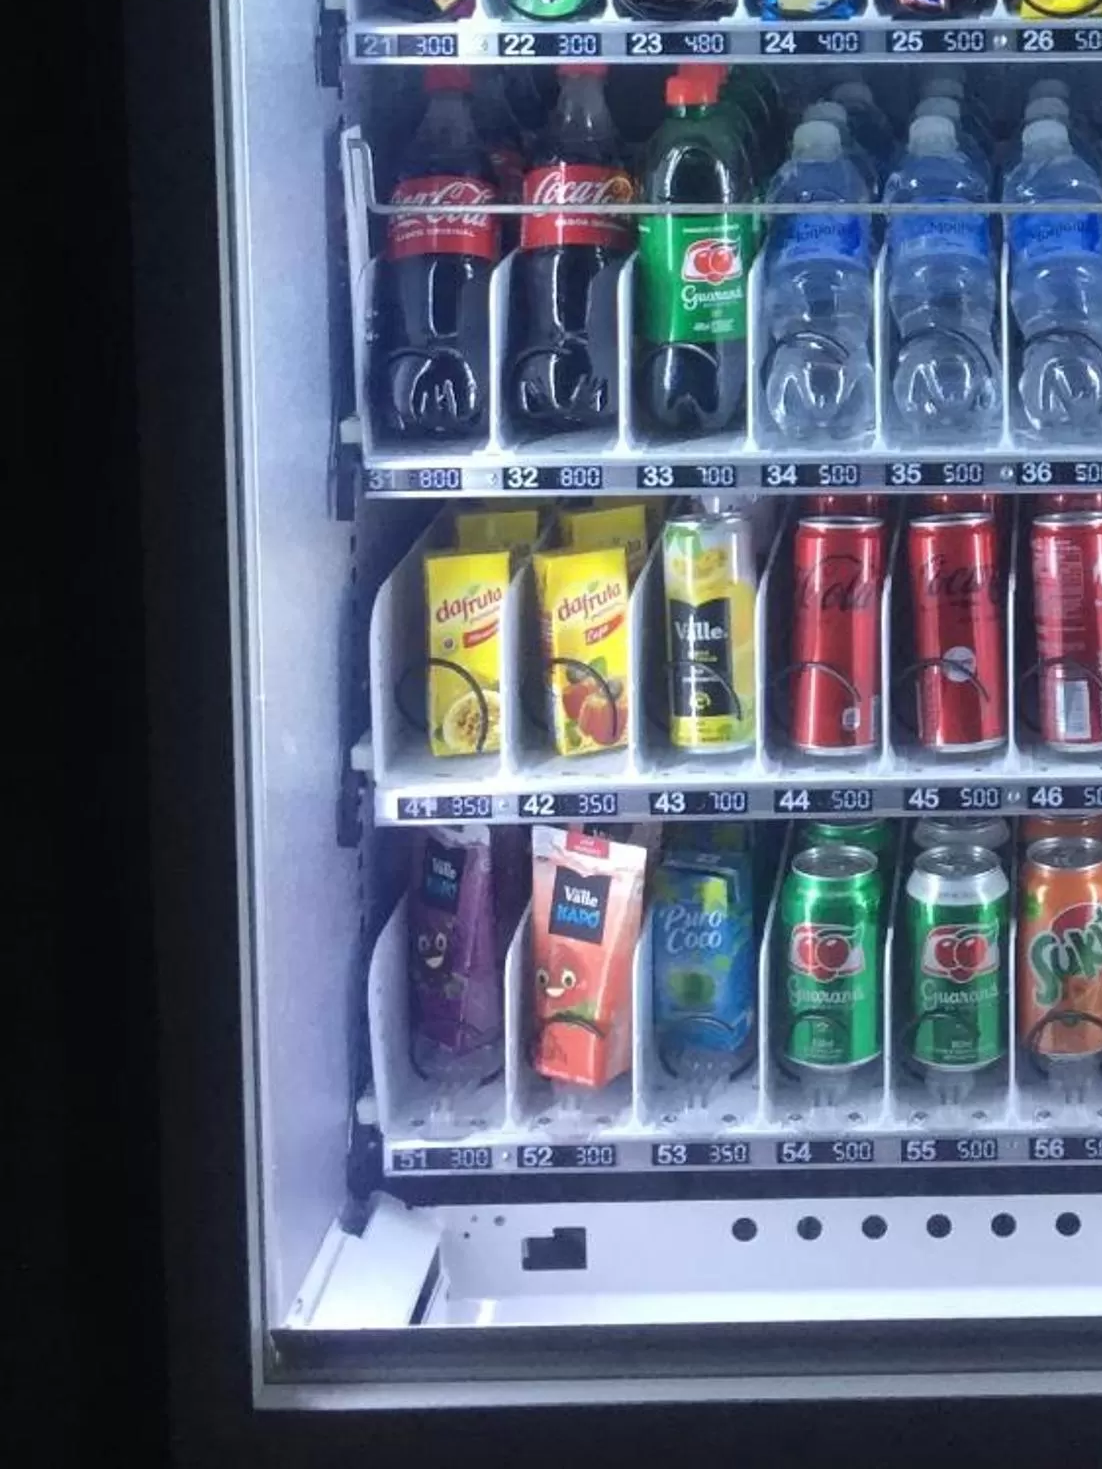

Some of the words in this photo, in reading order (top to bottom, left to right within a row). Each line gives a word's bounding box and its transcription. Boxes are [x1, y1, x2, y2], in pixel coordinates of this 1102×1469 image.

[363, 35, 391, 55] 21
[504, 35, 536, 55] 22
[632, 33, 662, 54] 23
[765, 32, 797, 53] 24
[893, 31, 923, 51] 25
[1023, 30, 1054, 51] 26
[508, 467, 538, 487] 32
[643, 466, 674, 486] 33
[767, 464, 797, 485] 34
[892, 463, 922, 483] 35
[1022, 462, 1052, 482] 36
[436, 587, 503, 623] dafruta
[558, 583, 622, 622] dafruta
[523, 794, 555, 815] 42
[654, 792, 686, 813] 43
[779, 790, 810, 811] 44
[908, 788, 940, 808] 45
[1031, 786, 1063, 807] 46
[664, 904, 722, 932] Puro
[667, 928, 722, 954] Coco
[523, 1146, 553, 1166] 52
[658, 1144, 687, 1164] 53
[782, 1142, 812, 1162] 54
[906, 1140, 937, 1160] 55
[1034, 1138, 1064, 1158] 56
[400, 1149, 428, 1168] 51
